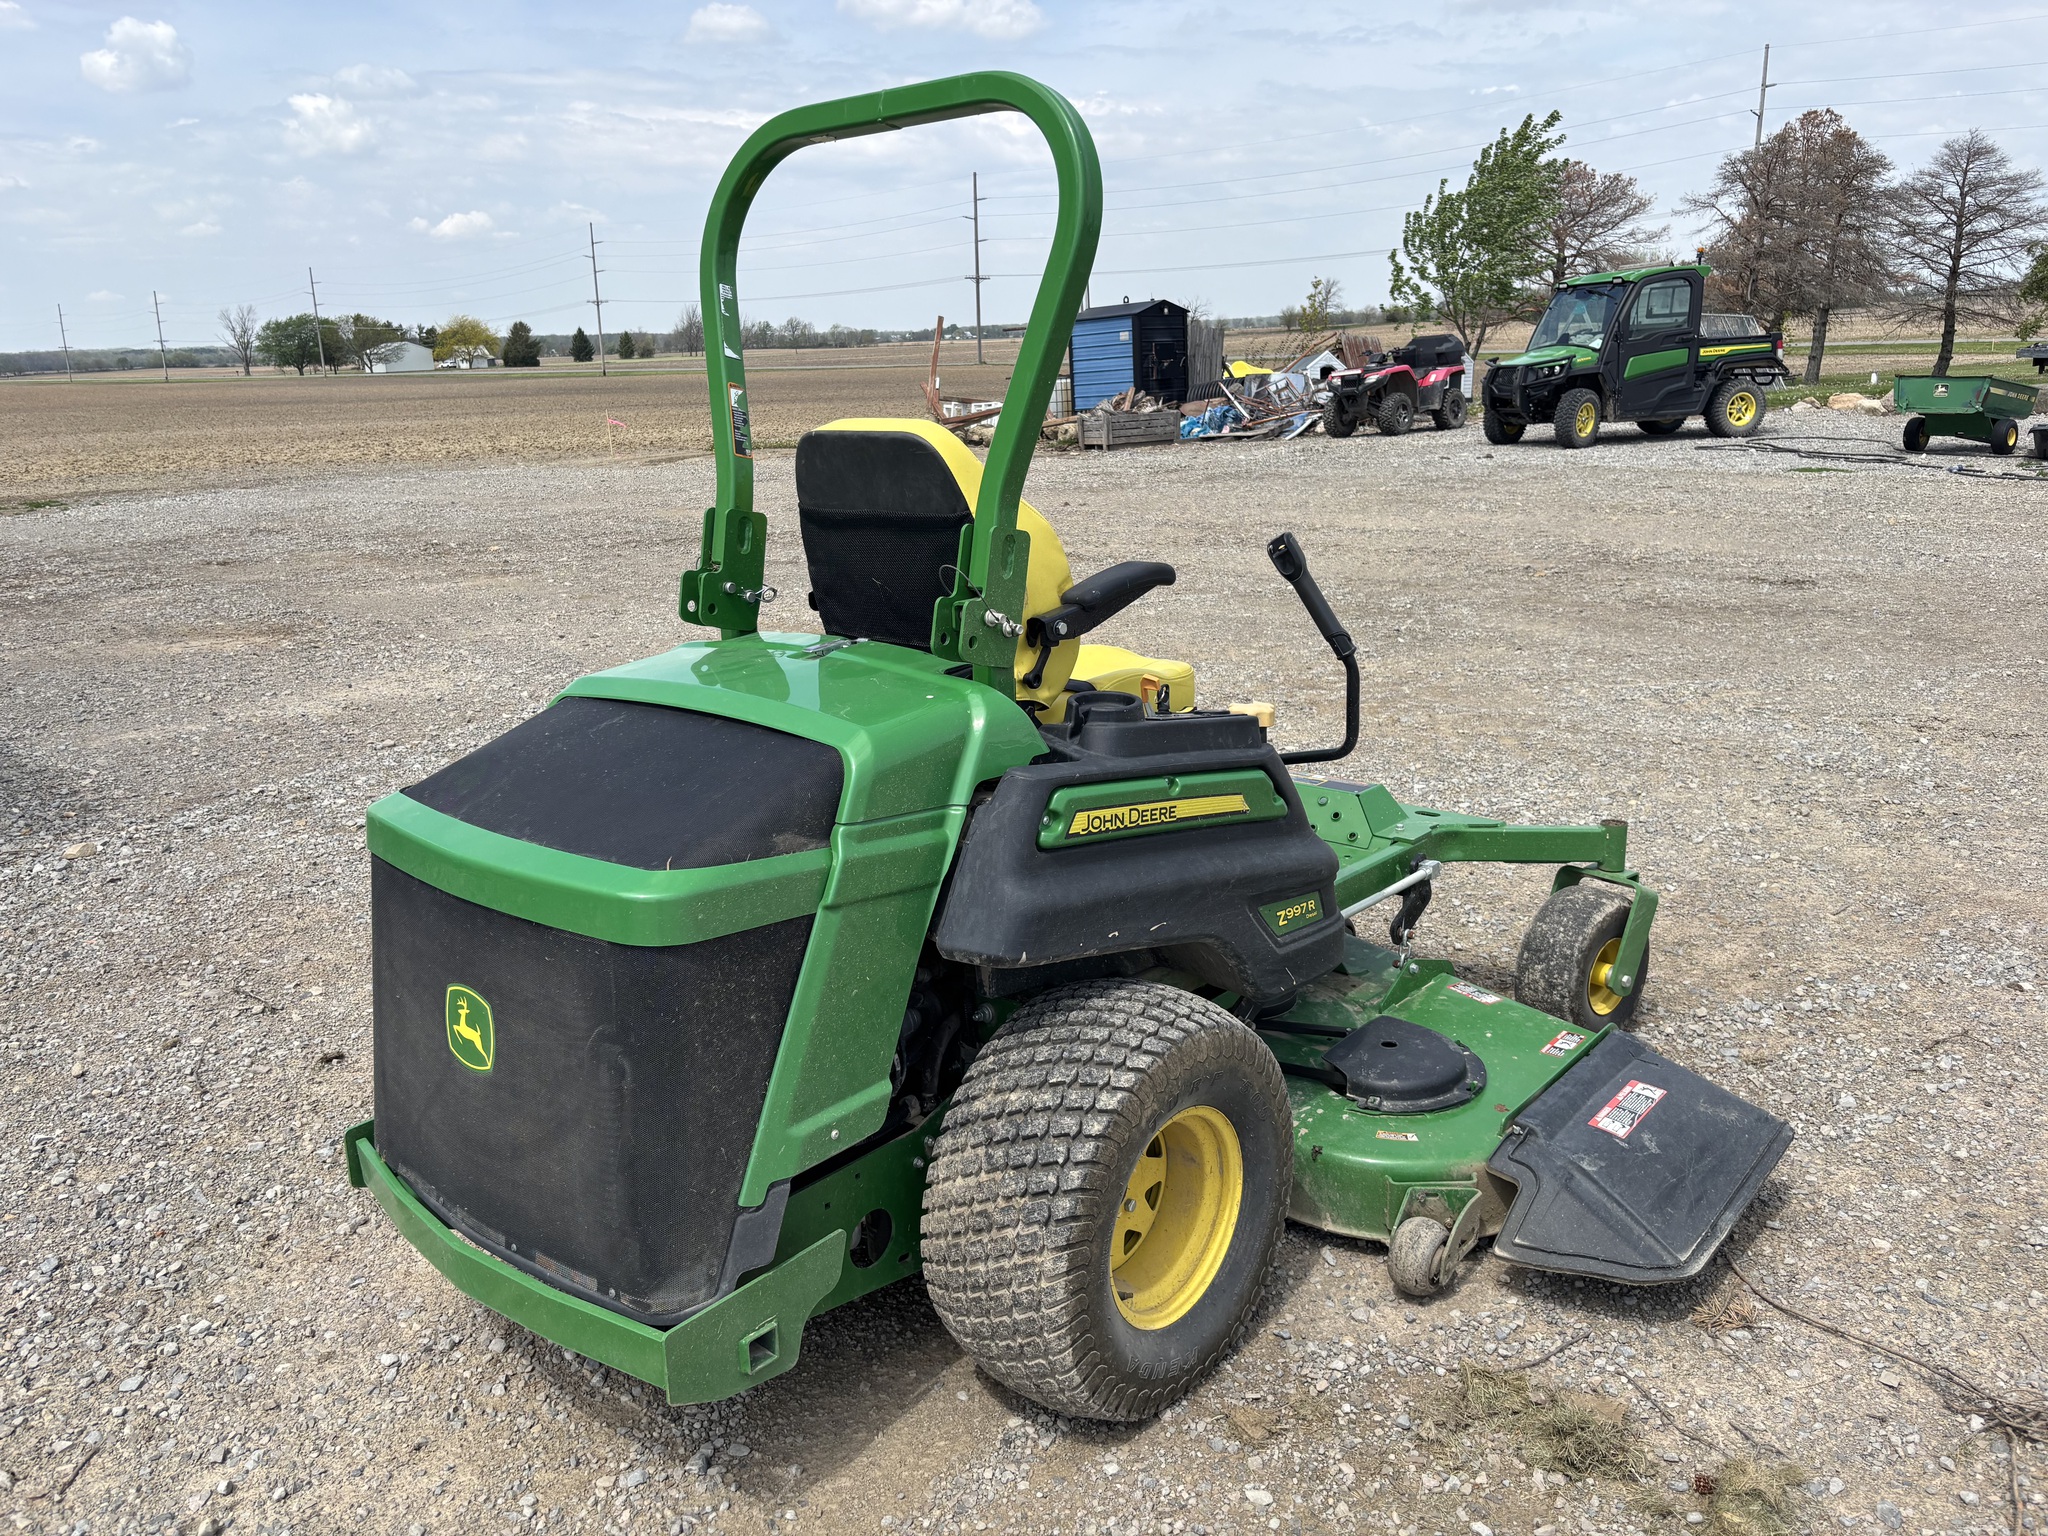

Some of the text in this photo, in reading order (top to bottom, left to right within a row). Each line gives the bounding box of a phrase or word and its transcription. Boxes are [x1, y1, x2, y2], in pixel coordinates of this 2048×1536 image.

[1081, 805, 1178, 832] JOHN DEERE
[1276, 899, 1316, 927] Z997R
[1126, 1345, 1199, 1380] KENDA
